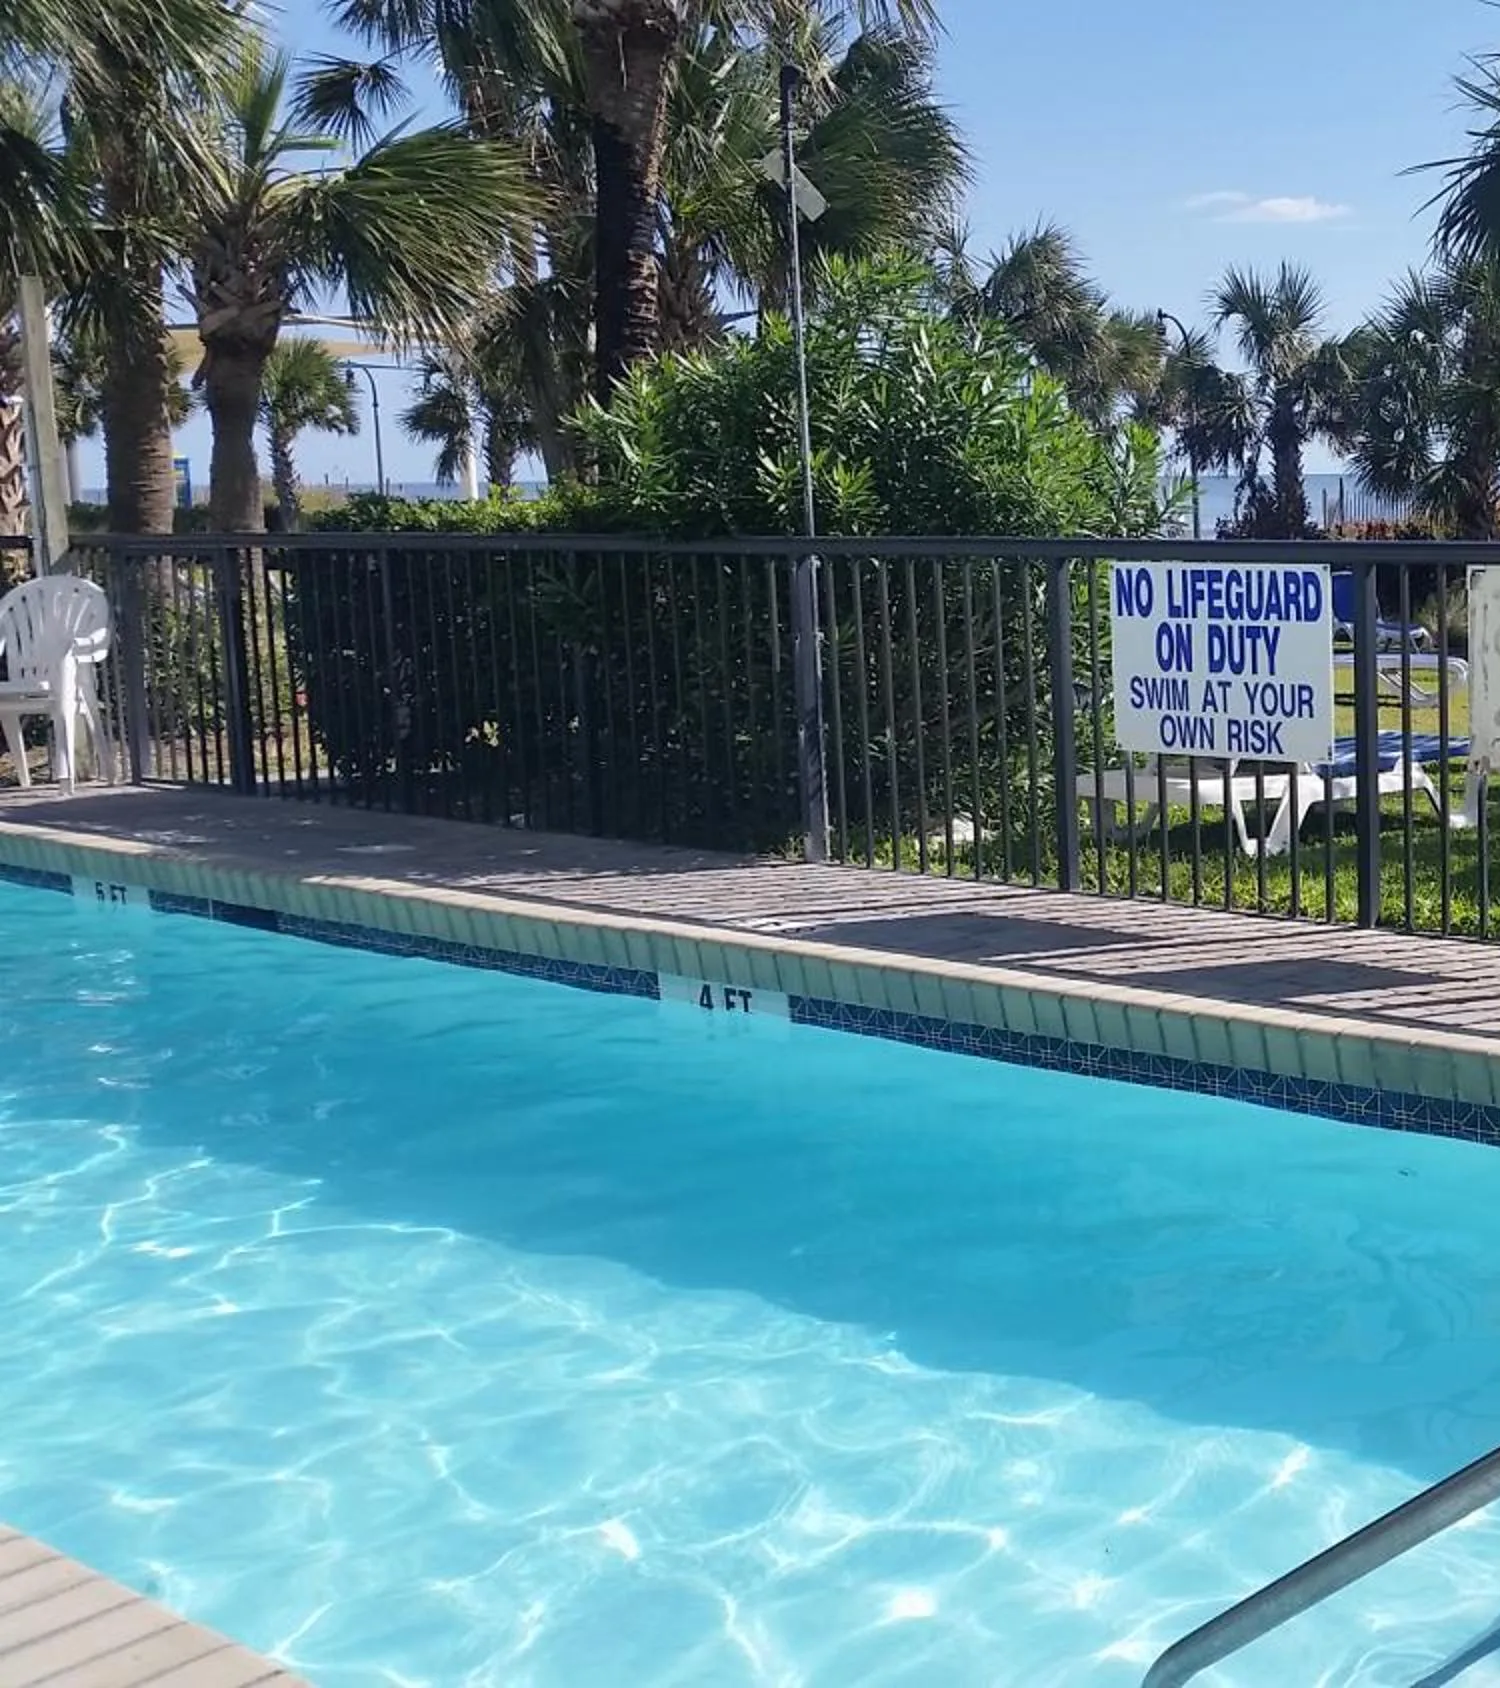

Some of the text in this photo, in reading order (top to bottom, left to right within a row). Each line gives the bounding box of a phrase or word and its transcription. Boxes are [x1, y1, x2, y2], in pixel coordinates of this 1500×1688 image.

[1115, 567, 1323, 623] NO LIFEGUARD
[1155, 621, 1281, 677] ON DUTY
[1130, 675, 1315, 719] SWIM AT YOUR
[1159, 714, 1285, 755] OWN RISK
[109, 884, 127, 905] FT
[699, 983, 753, 1013] 4 FT
